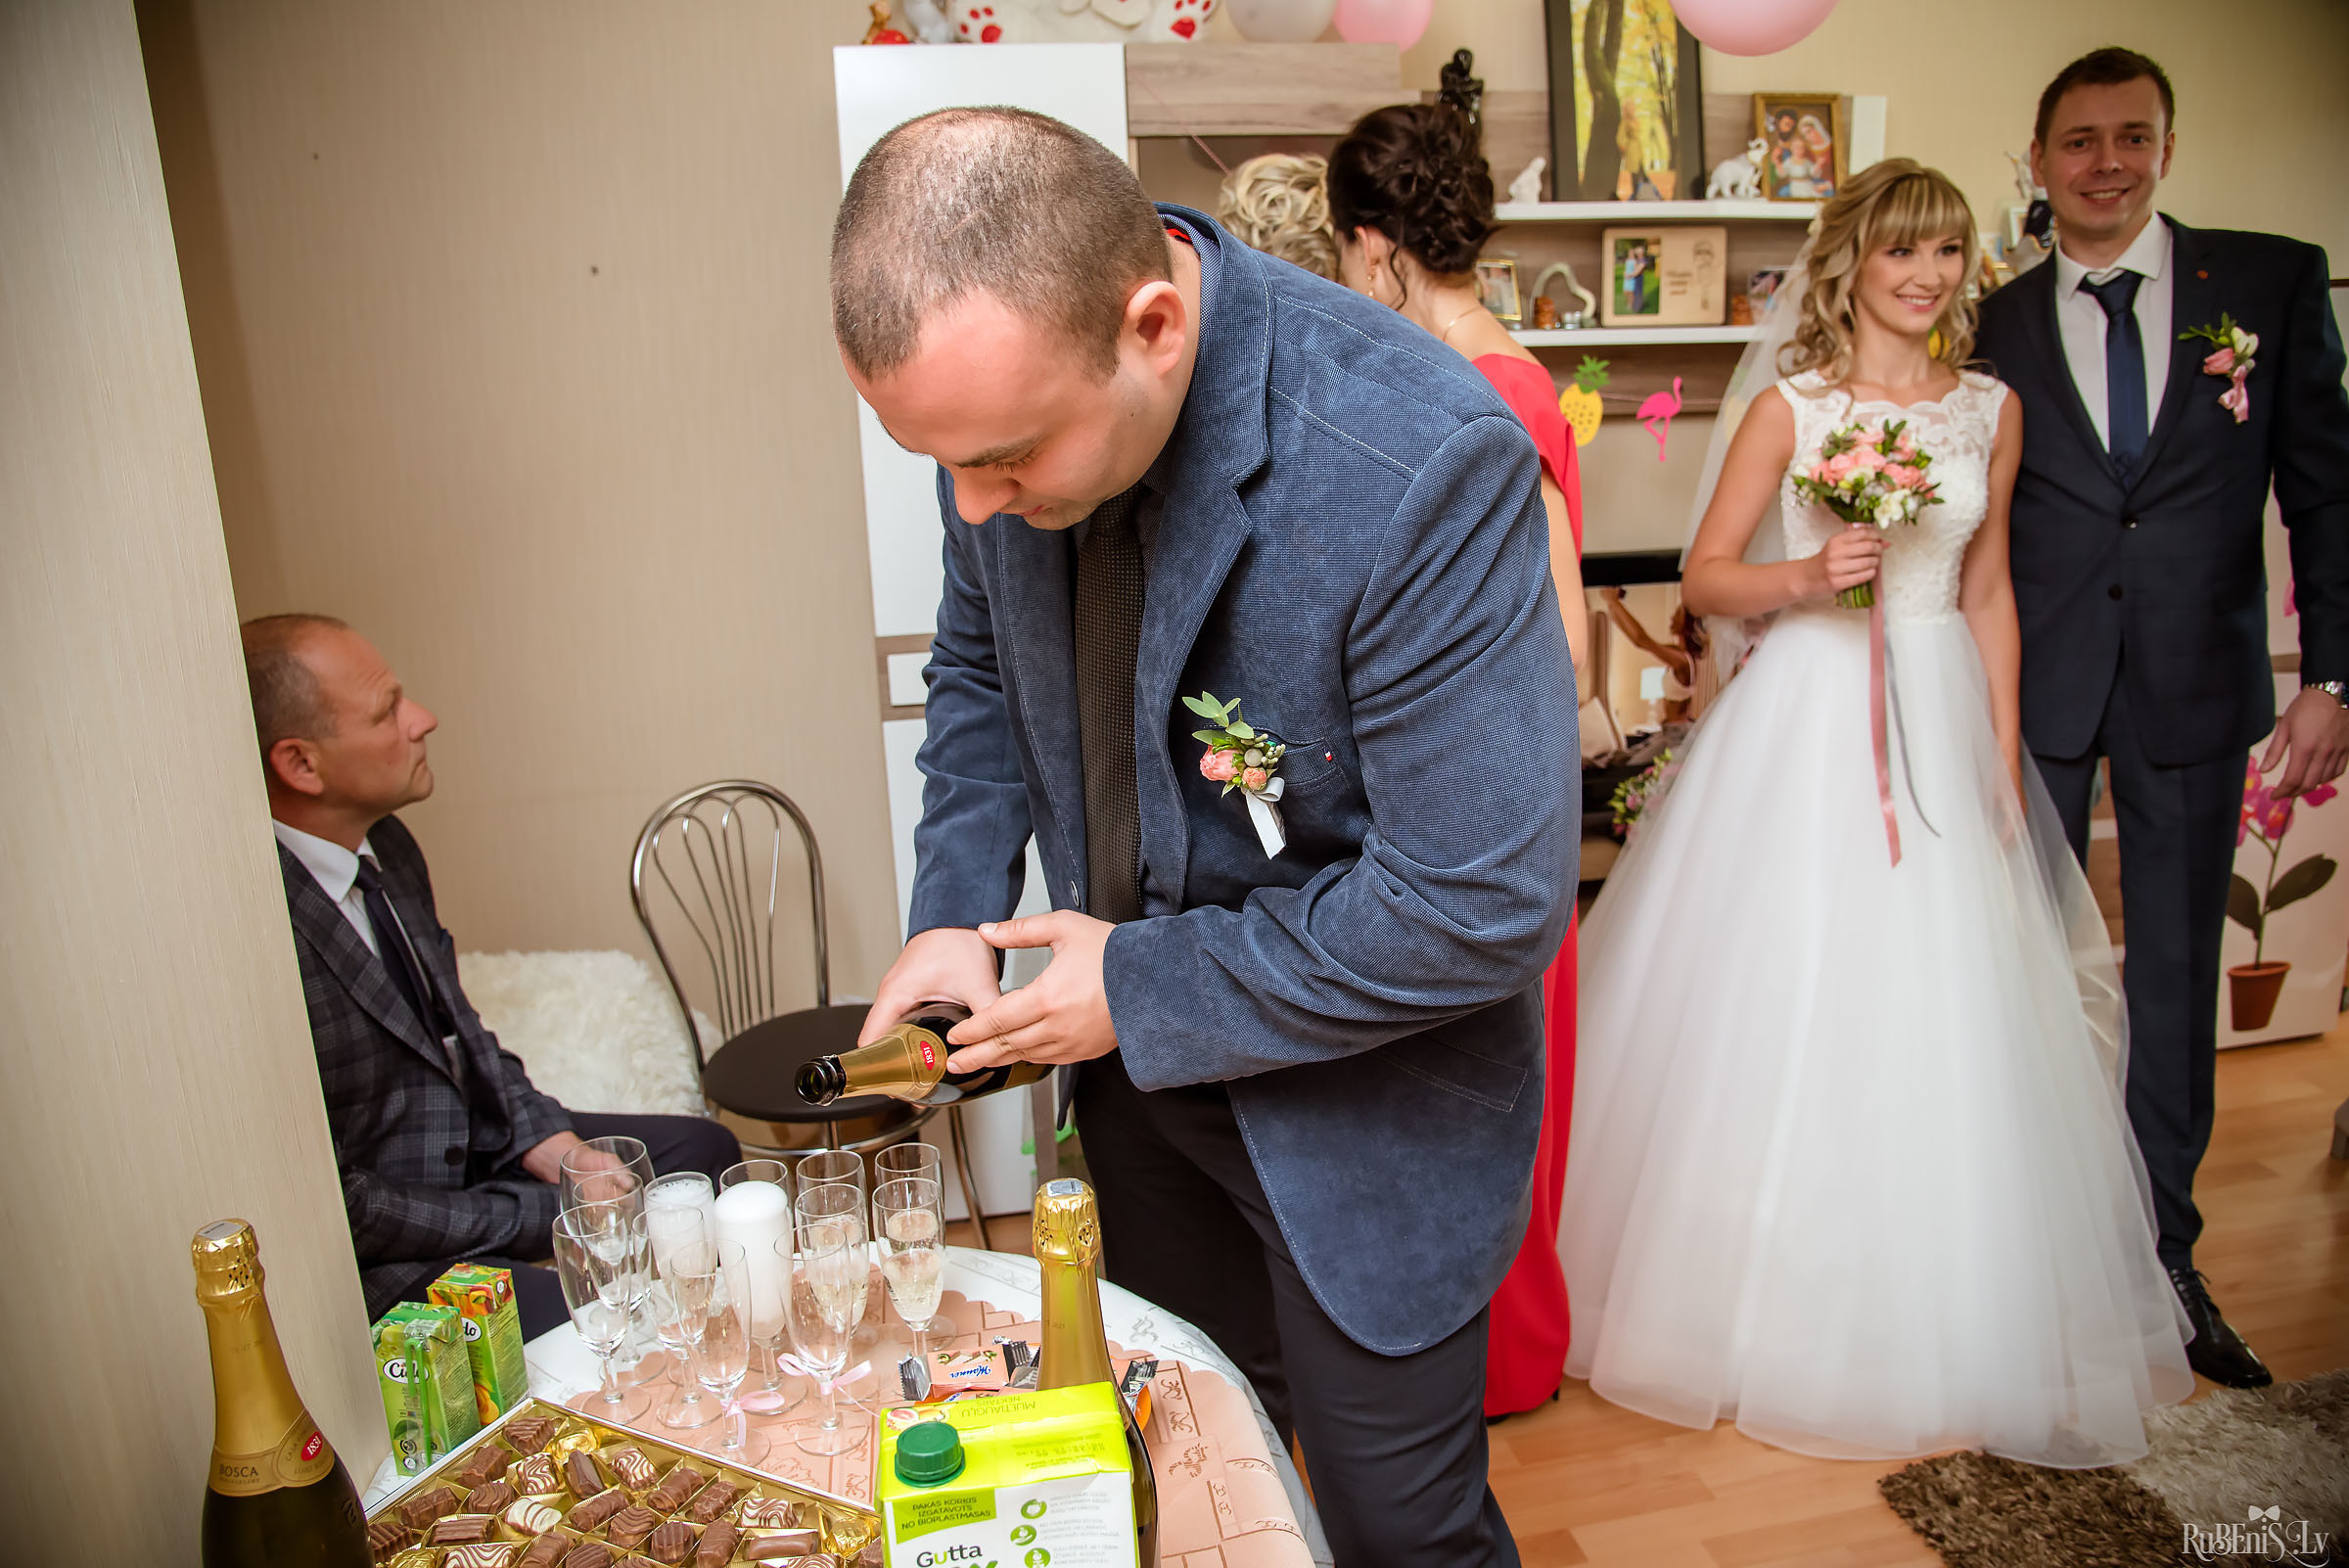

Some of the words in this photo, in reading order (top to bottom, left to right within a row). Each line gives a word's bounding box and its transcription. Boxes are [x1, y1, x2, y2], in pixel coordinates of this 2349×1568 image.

[923, 1046, 934, 1063] 1831
[949, 1365, 991, 1378] Manner
[306, 1435, 322, 1455] 1831
[219, 1463, 259, 1478] BOSCA
[912, 1499, 942, 1511] PAKAS
[918, 1504, 973, 1518] IZGATAVOTS
[901, 1520, 916, 1531] NO
[917, 1509, 991, 1527] BIOPLASTMASAS
[916, 1544, 983, 1568] Gutta
